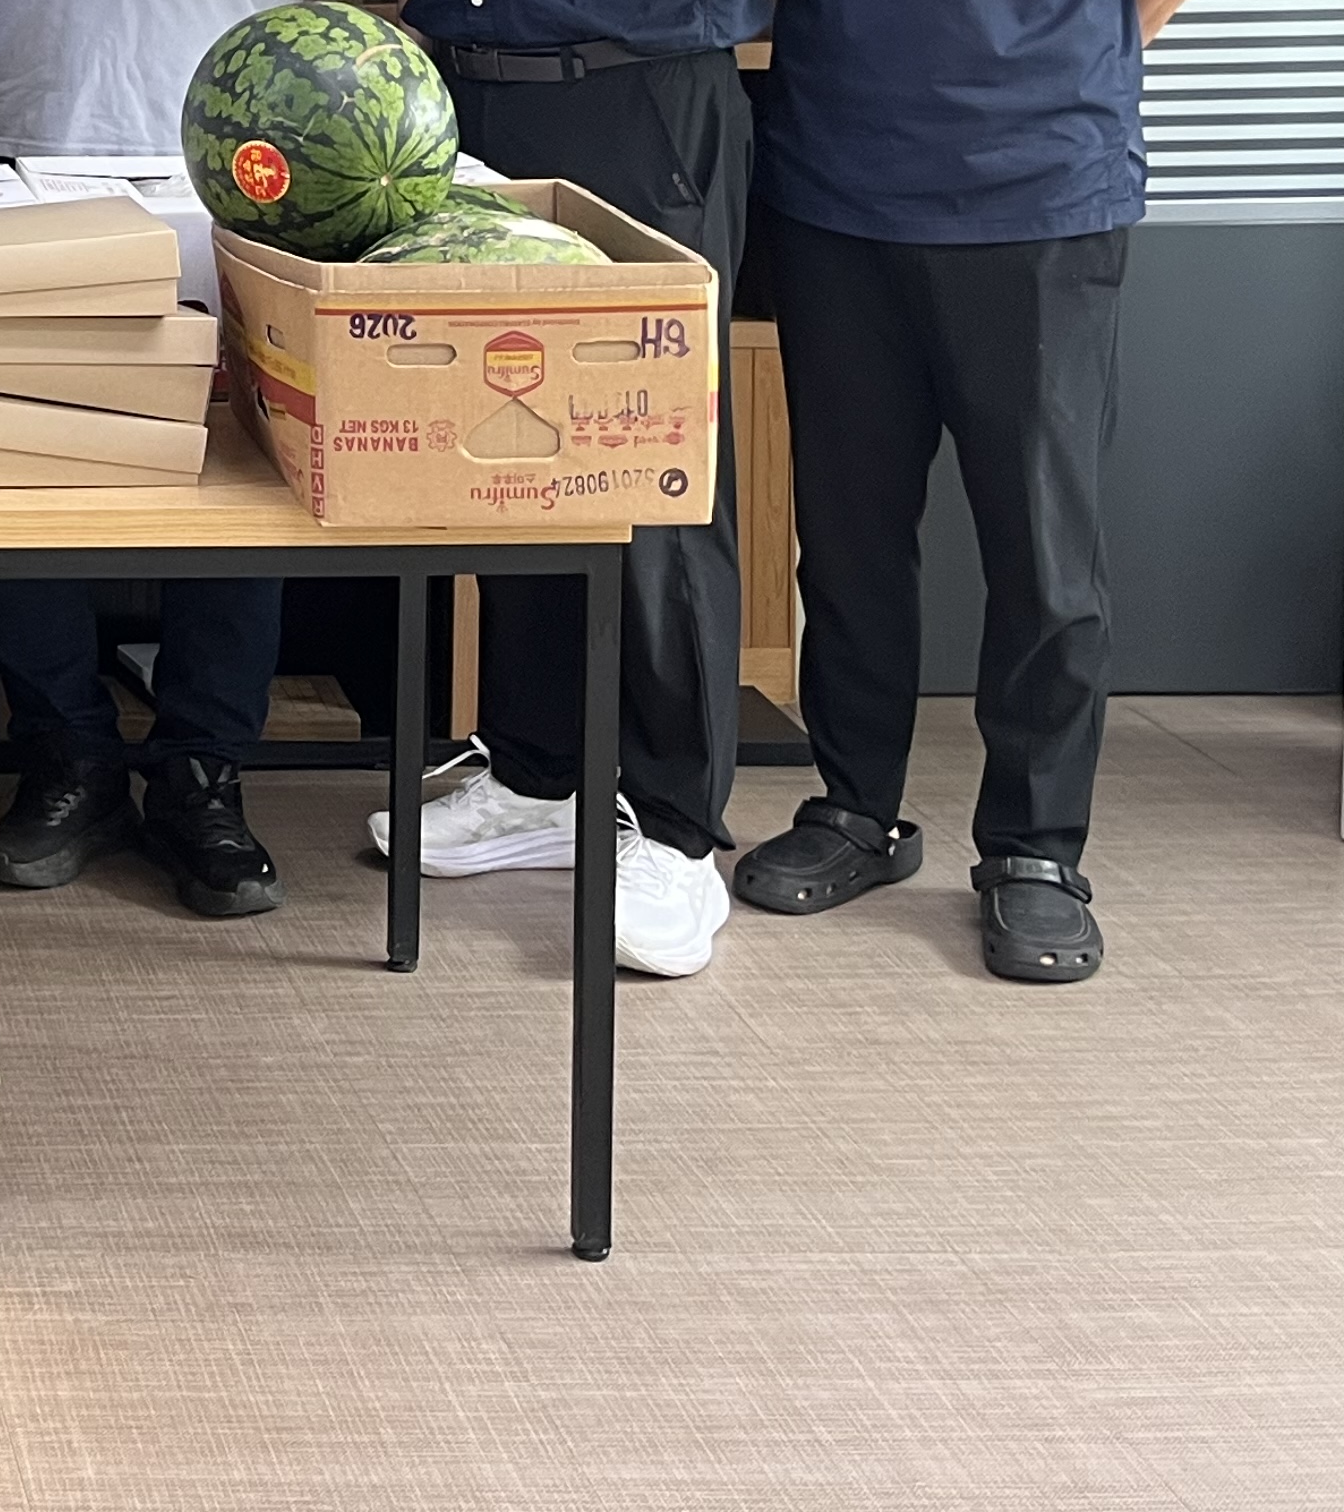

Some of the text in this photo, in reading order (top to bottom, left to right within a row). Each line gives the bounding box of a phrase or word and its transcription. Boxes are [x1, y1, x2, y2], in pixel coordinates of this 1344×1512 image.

[338, 419, 419, 434] 13 KGS NET
[332, 436, 419, 452] BANANAS
[469, 485, 557, 511] Sumifru
